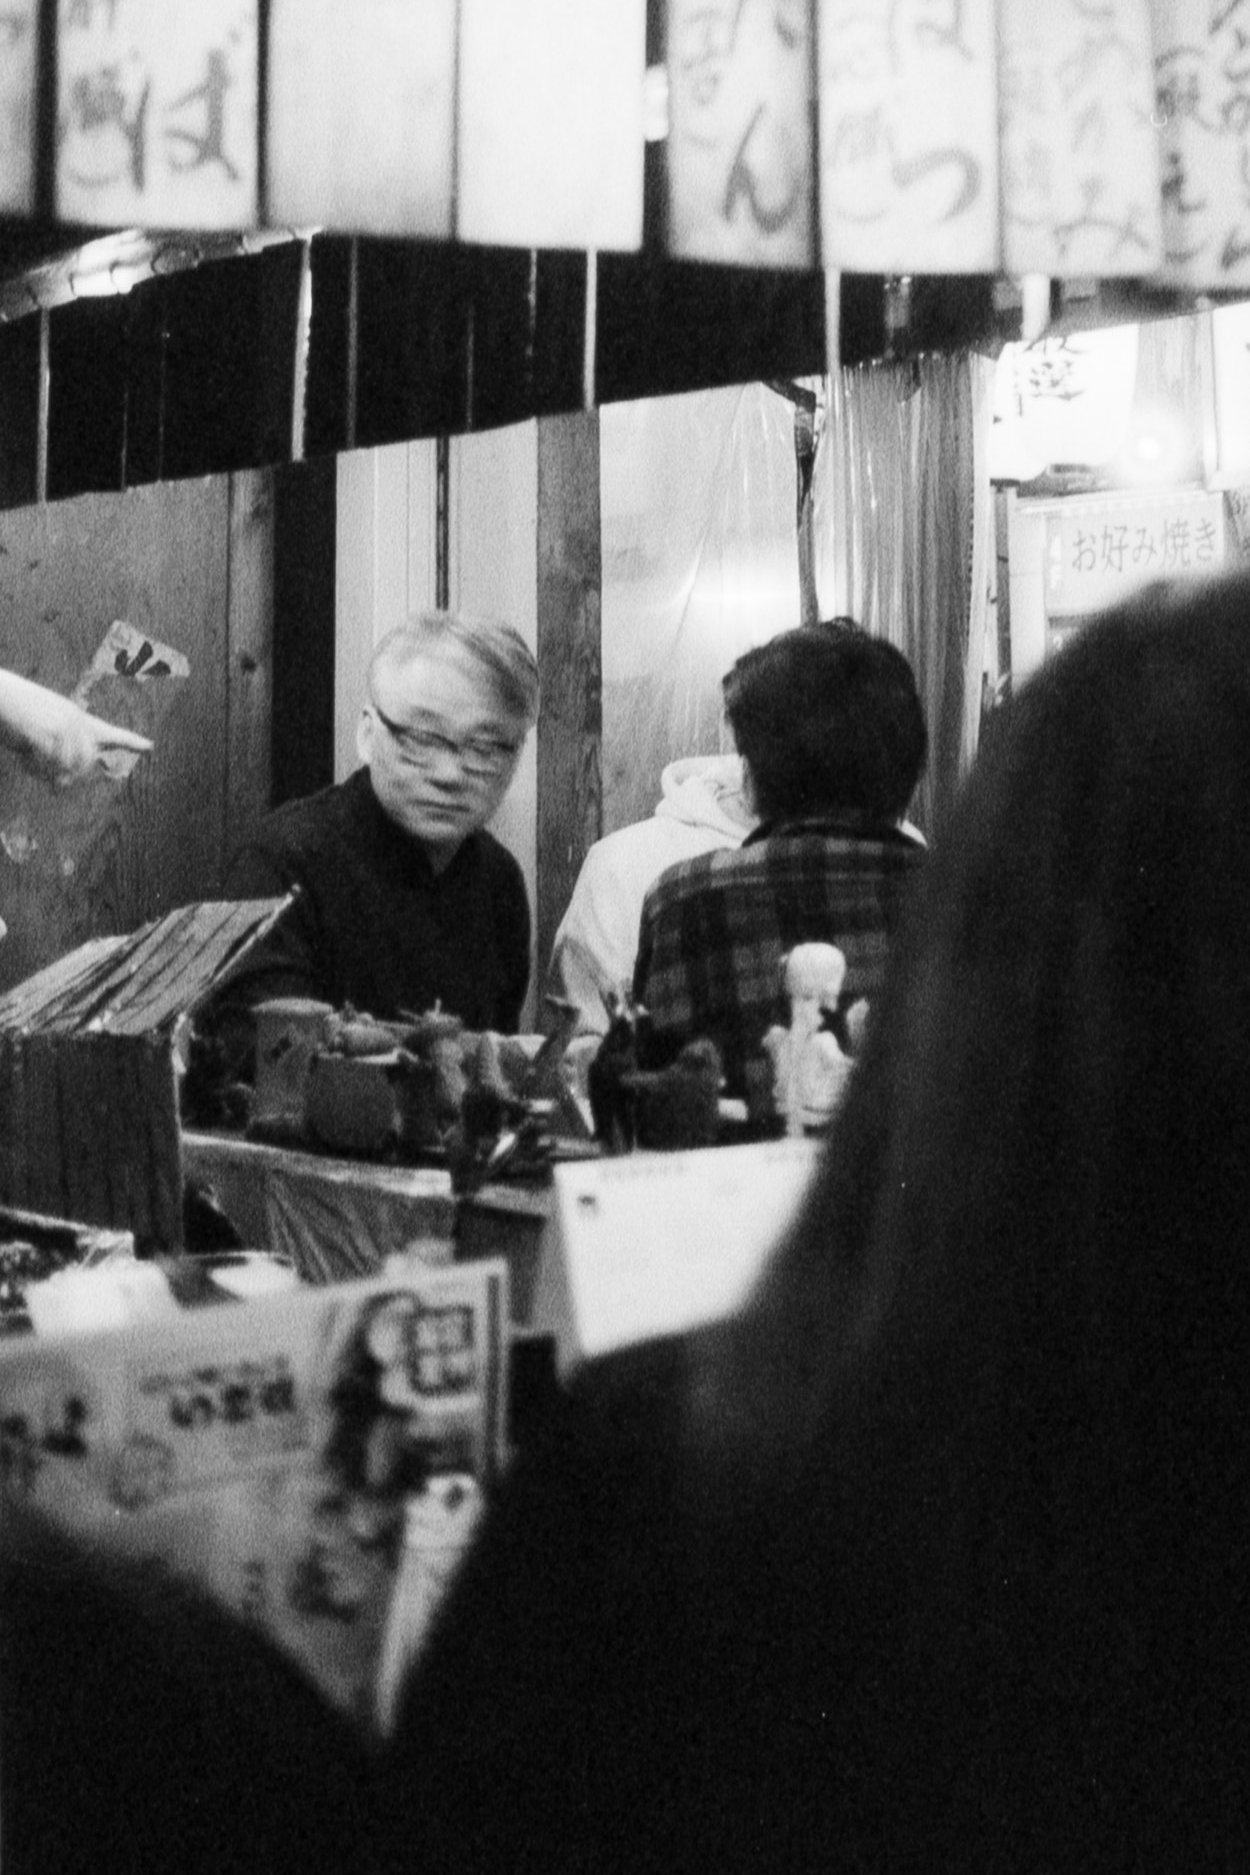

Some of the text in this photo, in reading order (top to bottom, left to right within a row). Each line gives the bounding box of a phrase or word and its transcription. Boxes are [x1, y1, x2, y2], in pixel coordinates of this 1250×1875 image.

[1072, 518, 1216, 573] お好み焼き
